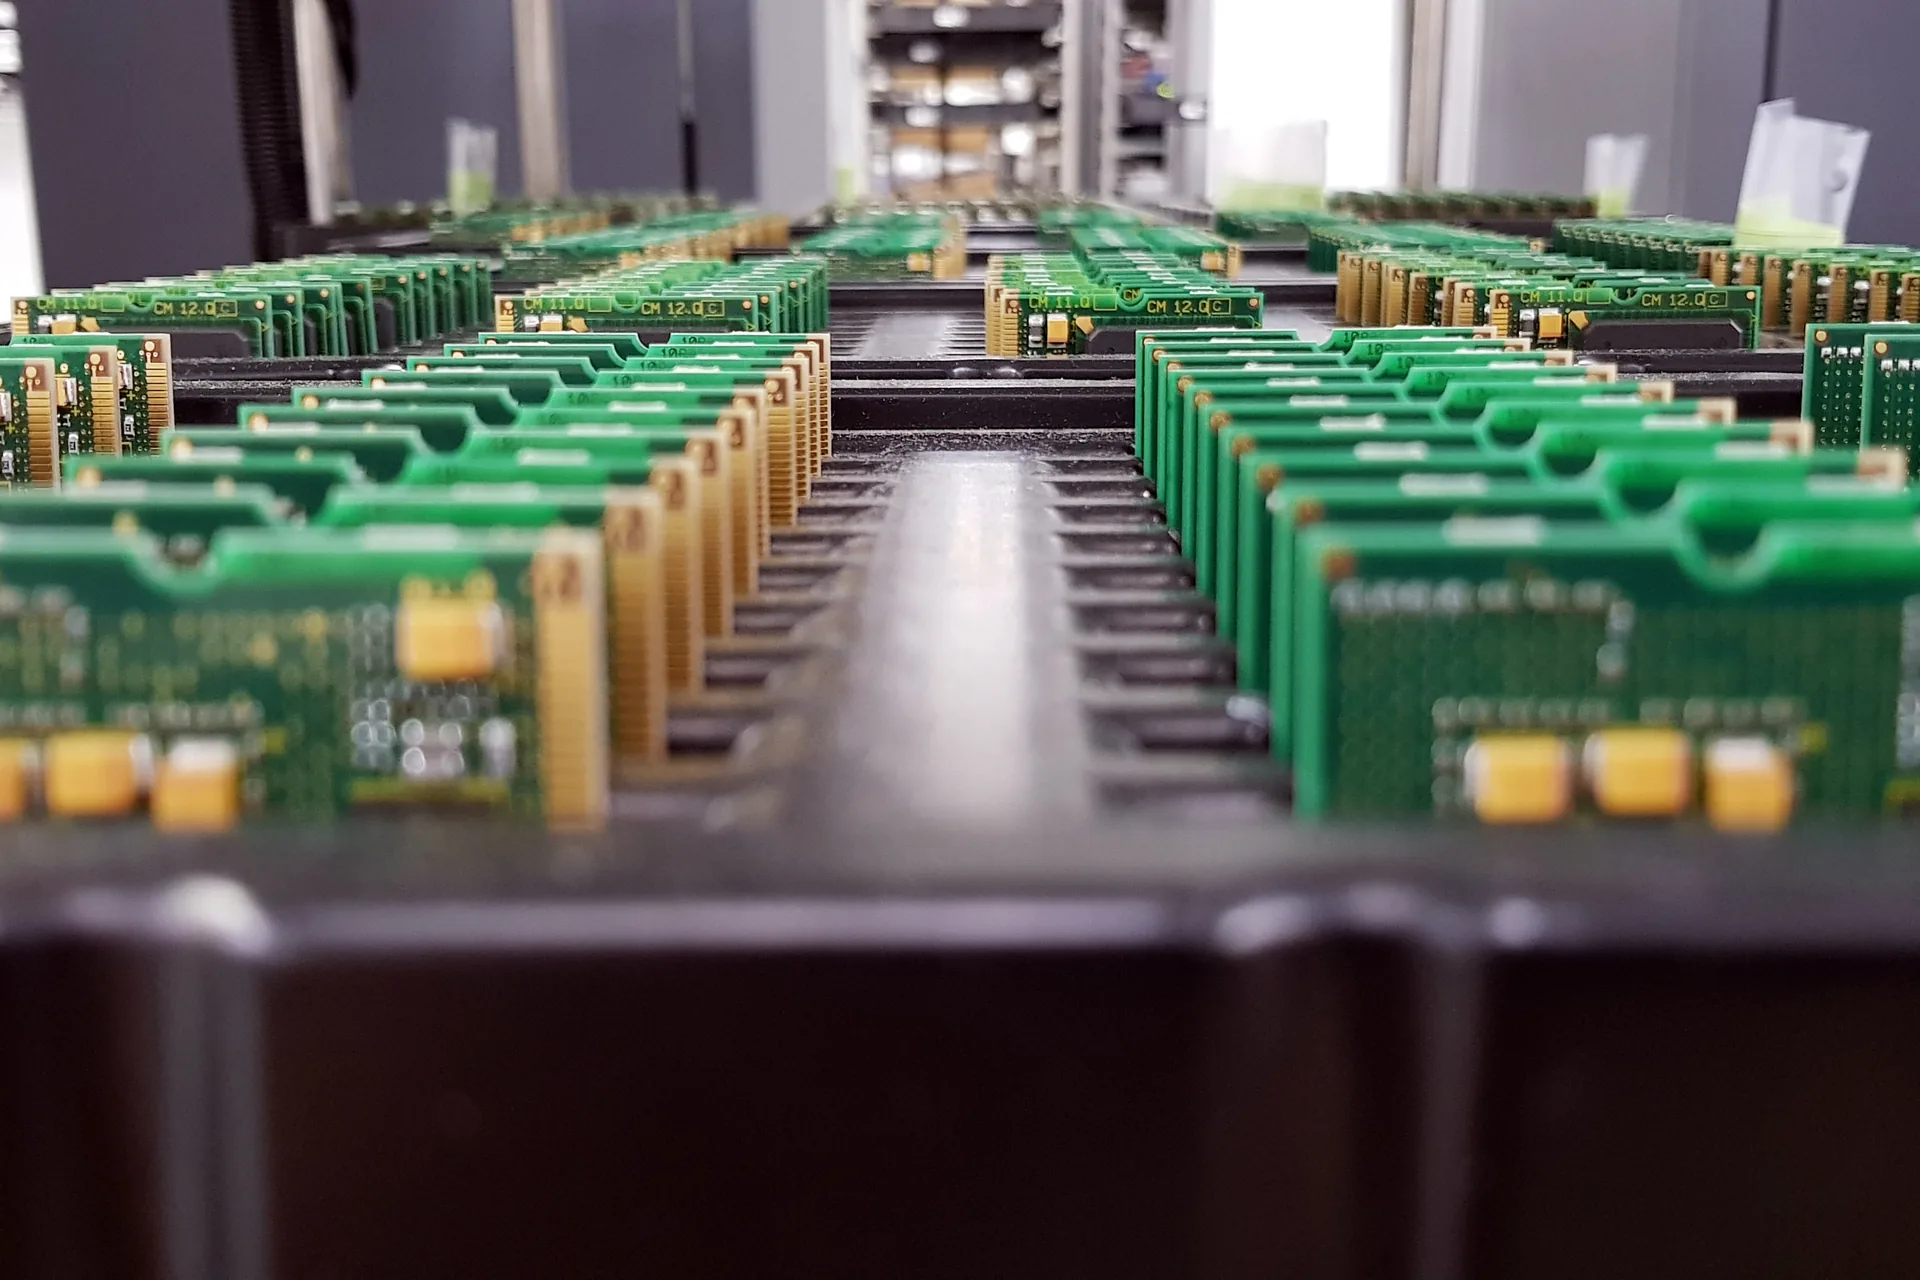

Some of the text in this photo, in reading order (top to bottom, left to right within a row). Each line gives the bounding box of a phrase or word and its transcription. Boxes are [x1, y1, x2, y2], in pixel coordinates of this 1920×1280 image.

[1029, 296, 1049, 309] CM
[1520, 290, 1540, 303] CM
[1641, 294, 1661, 307] CM
[154, 302, 174, 315] CM
[523, 298, 543, 310] CM
[641, 302, 661, 315] CM
[1147, 300, 1167, 313] CM
